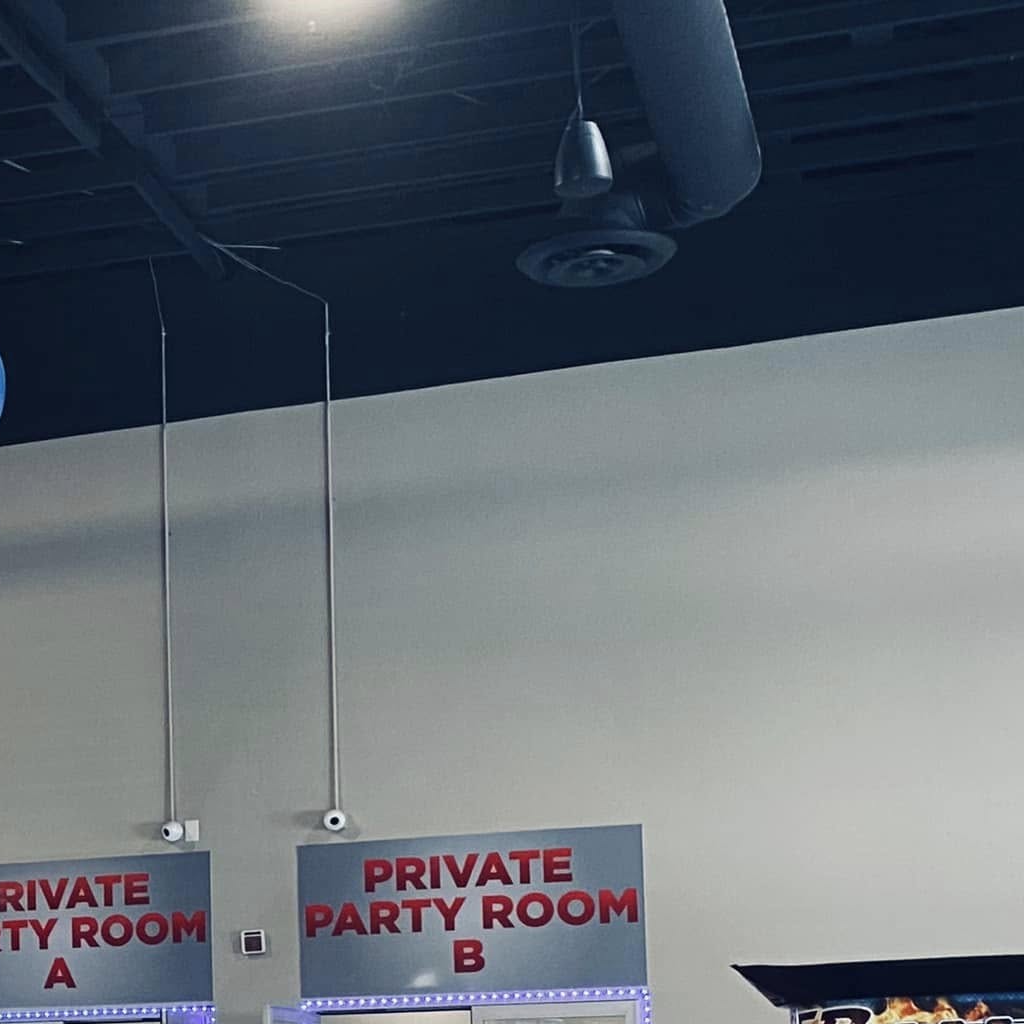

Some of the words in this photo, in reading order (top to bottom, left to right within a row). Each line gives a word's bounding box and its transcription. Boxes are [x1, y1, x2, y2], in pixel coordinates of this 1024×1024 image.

[363, 848, 573, 893] PRIVATE
[71, 910, 208, 949] ROOM
[304, 897, 466, 938] PARTY
[481, 888, 639, 930] ROOM
[44, 957, 77, 989] A
[453, 939, 486, 974] B
